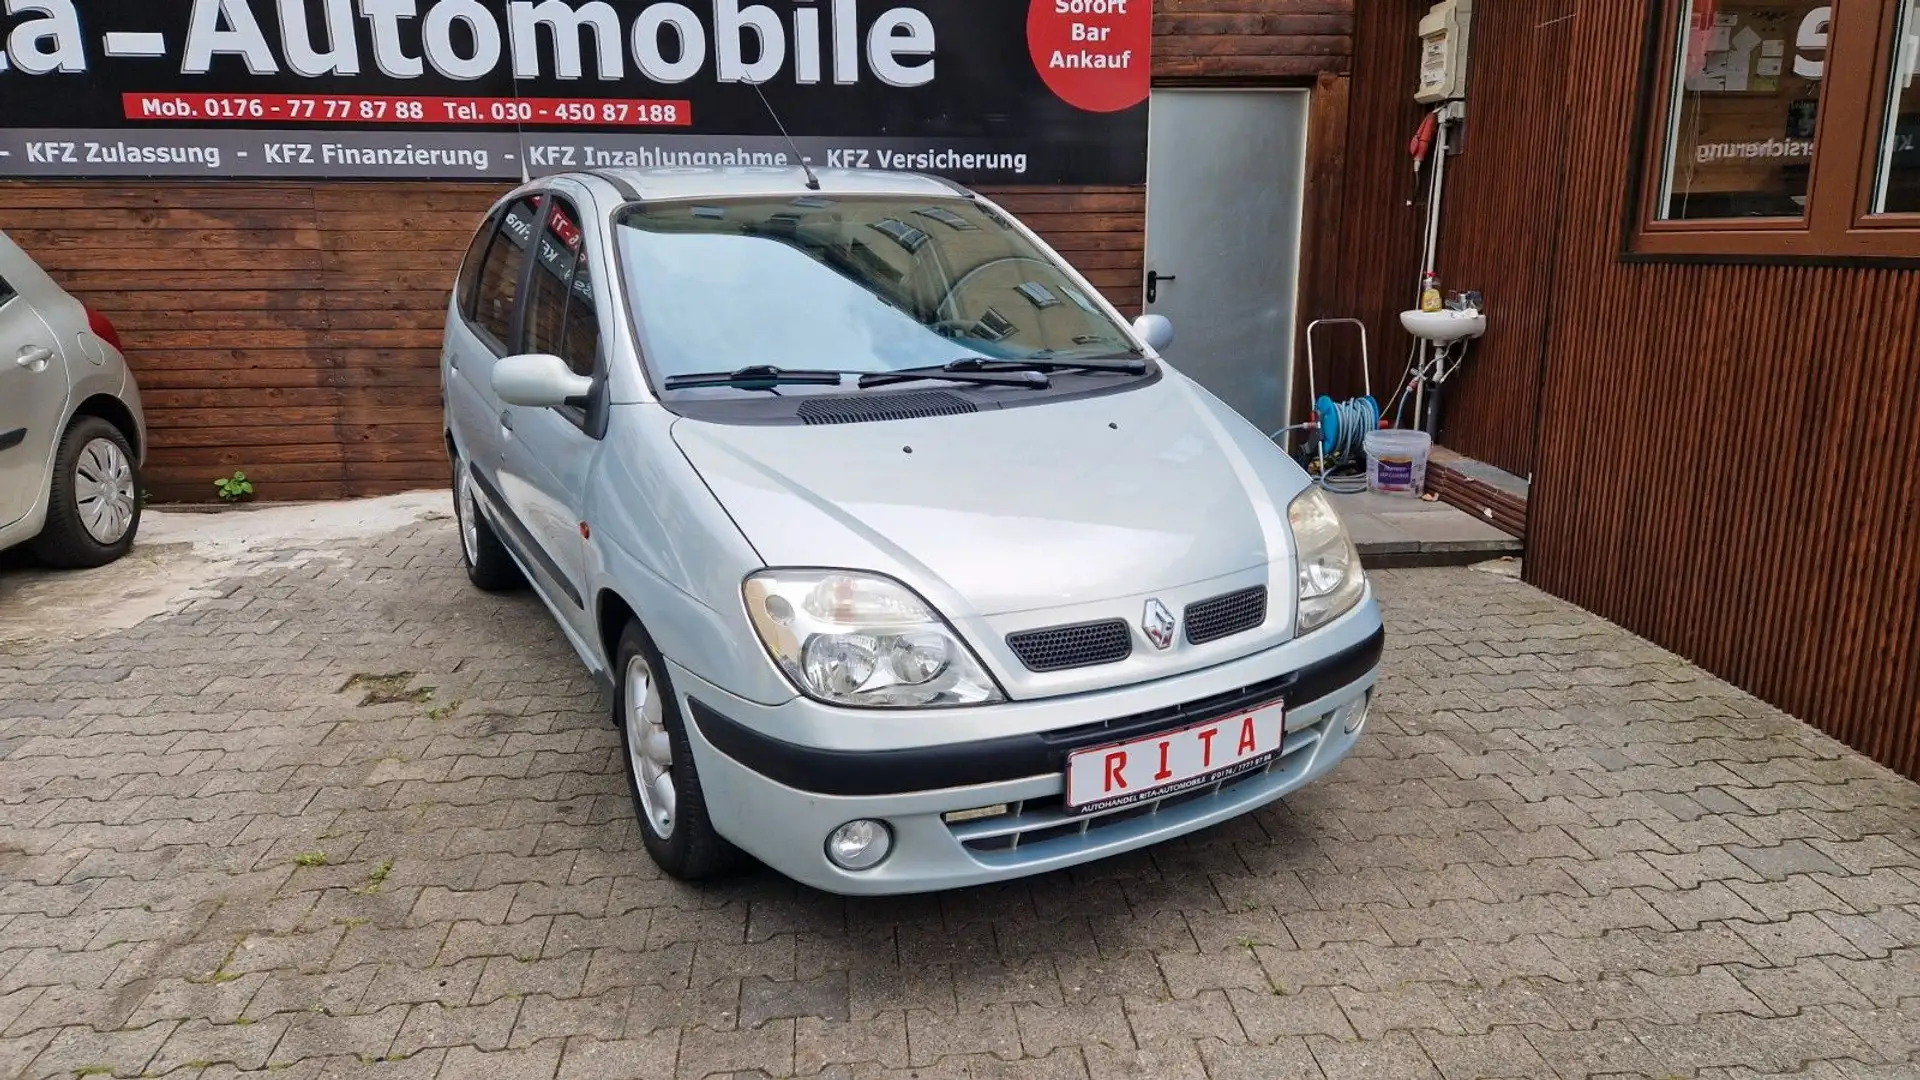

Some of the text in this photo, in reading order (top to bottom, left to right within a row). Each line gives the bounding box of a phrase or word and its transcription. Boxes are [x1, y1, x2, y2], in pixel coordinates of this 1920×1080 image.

[1055, 0, 1127, 14] Sofort
[1071, 23, 1111, 41] Bar
[1049, 50, 1131, 68] Ankauf
[142, 98, 198, 117] Mob.
[205, 99, 263, 117] 0176
[287, 100, 315, 117] 77
[323, 100, 351, 118] 77
[360, 101, 386, 119] 87
[394, 102, 424, 119] 88
[443, 102, 483, 120] Tel.
[491, 103, 532, 120] 030
[554, 104, 595, 121] 450
[602, 105, 628, 122] 87
[637, 104, 677, 122] 188
[26, 142, 78, 163] KFZ
[84, 142, 220, 168] Zulassung
[264, 144, 314, 164] KFZ
[321, 144, 488, 170] Finanzierung
[529, 146, 577, 166] KFZ
[584, 146, 788, 166] Inzahlungnahme
[827, 149, 870, 168] KFZ
[877, 149, 1028, 173] Versicherung
[1081, 795, 1138, 813] AUTOHANDEL
